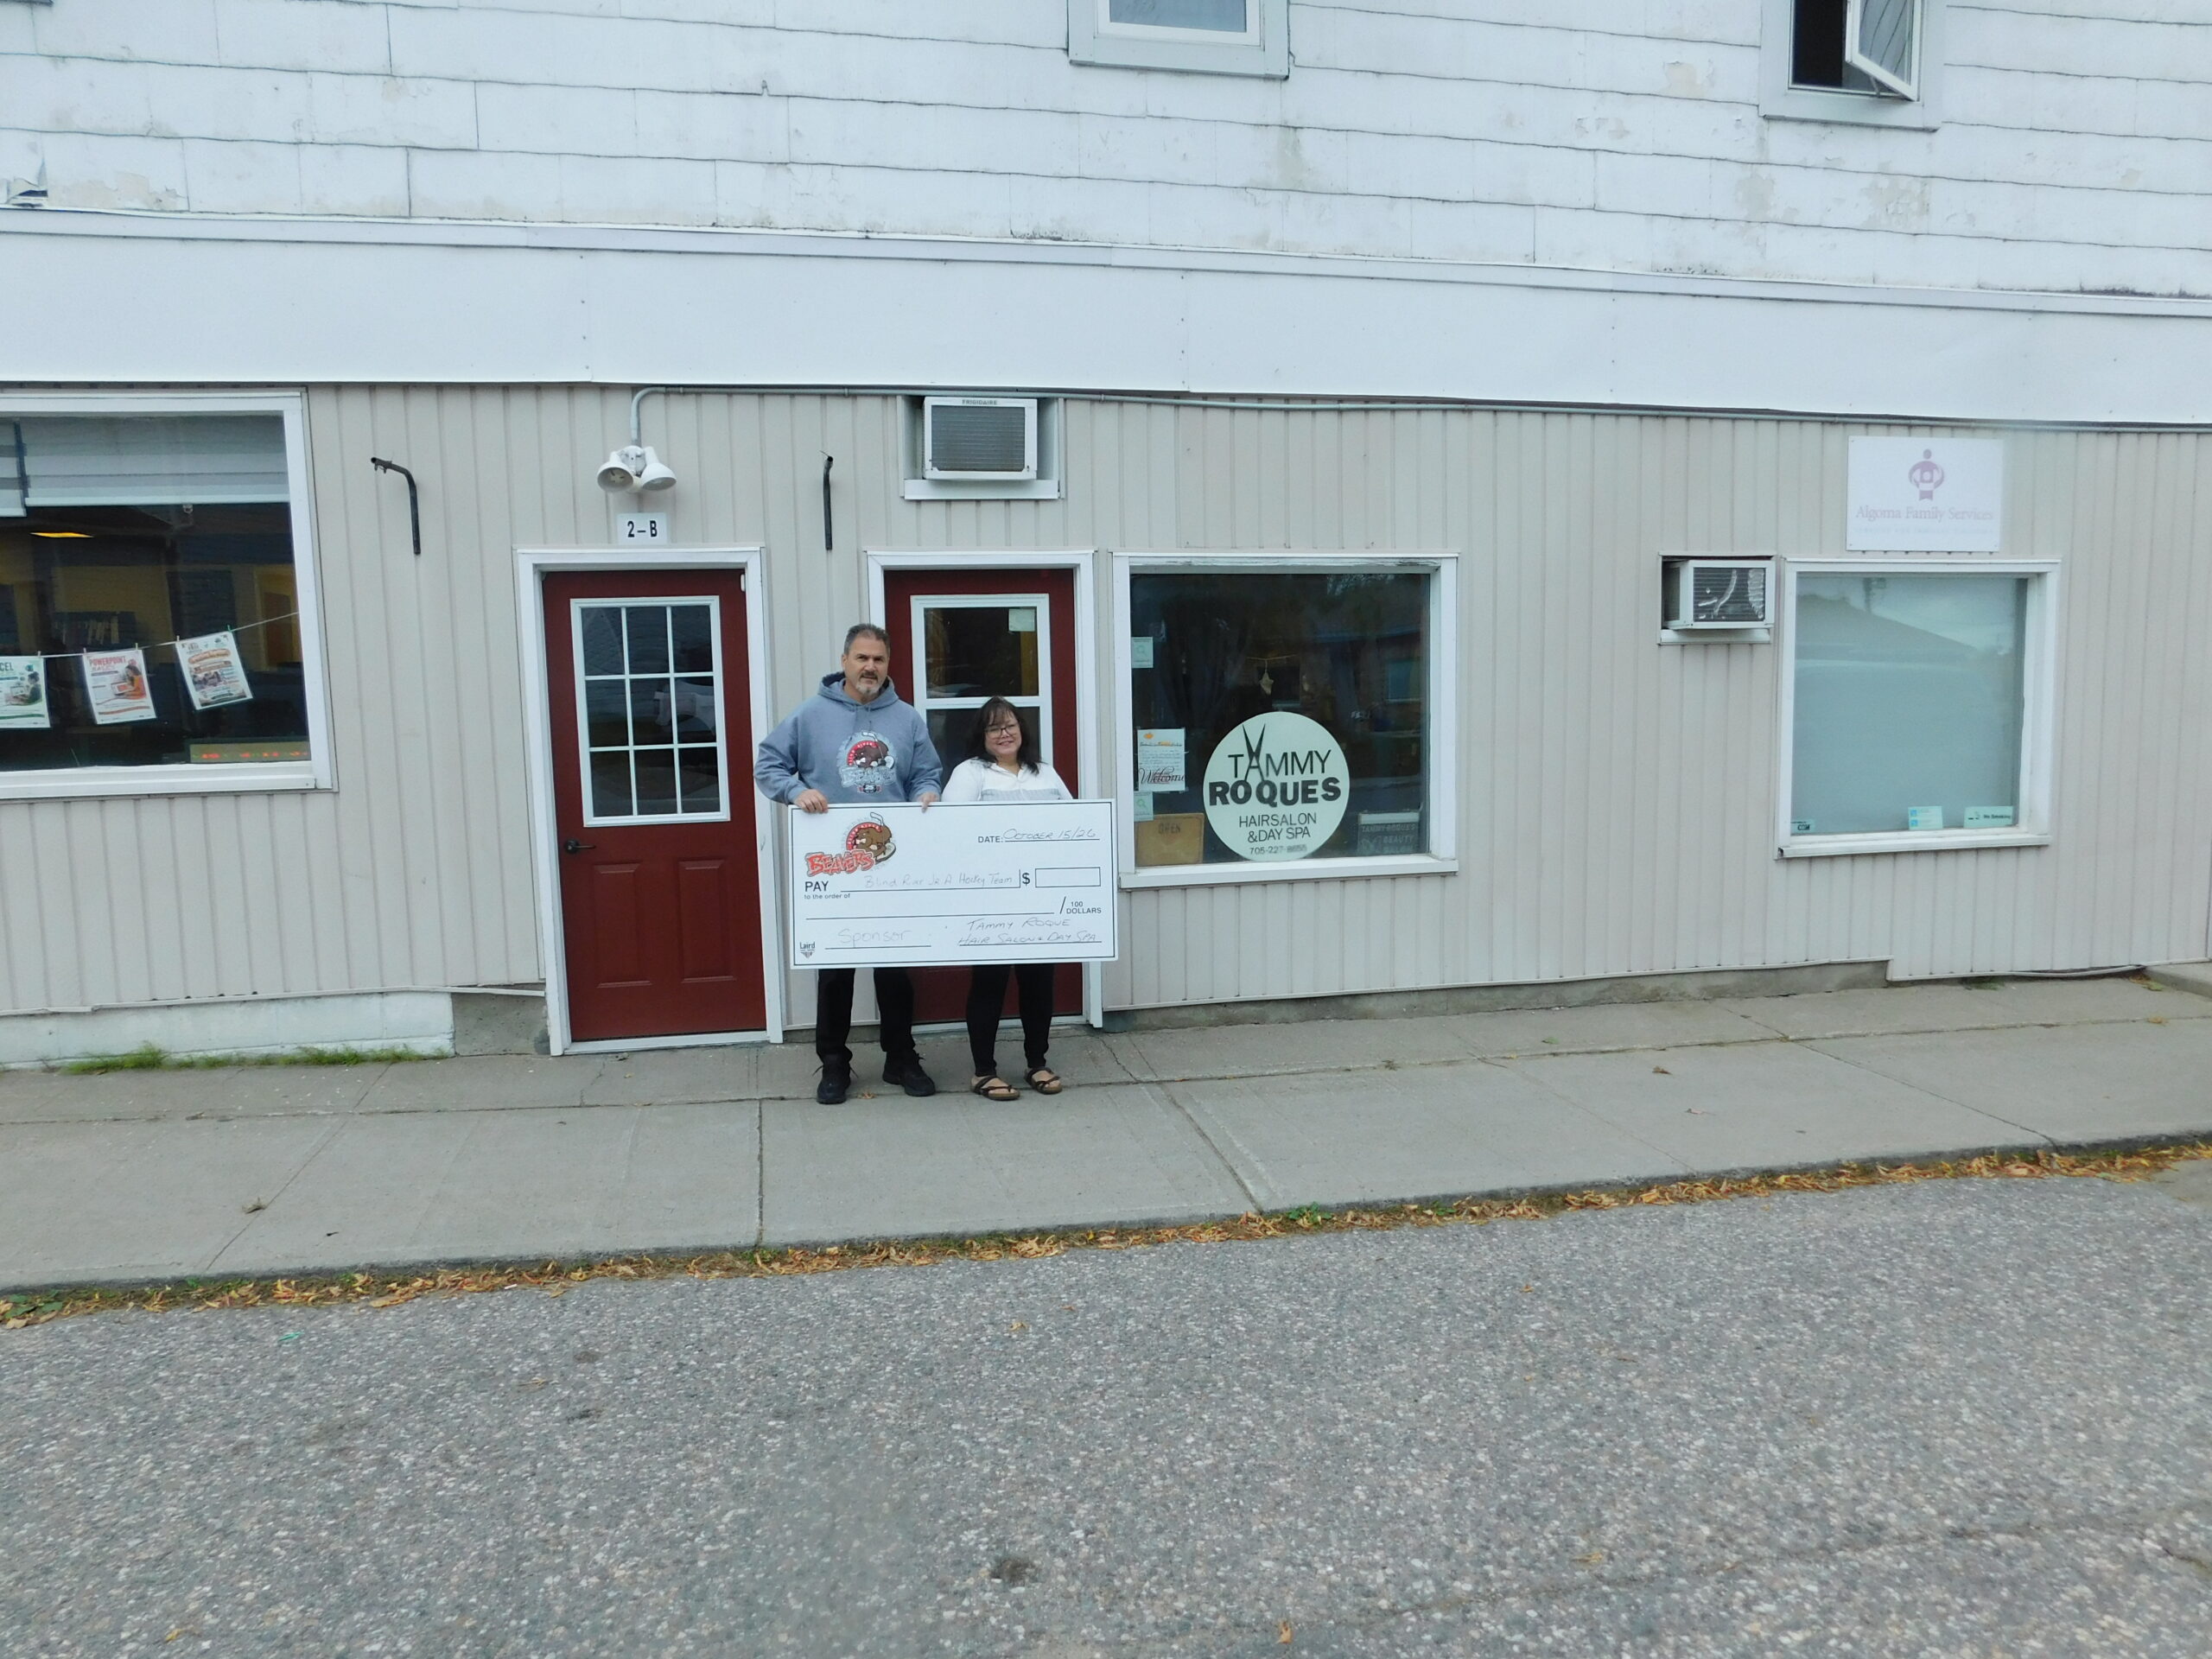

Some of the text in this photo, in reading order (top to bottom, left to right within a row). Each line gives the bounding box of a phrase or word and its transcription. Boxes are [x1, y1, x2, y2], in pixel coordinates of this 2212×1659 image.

[1856, 505, 1993, 523] Algoma Family Services
[627, 520, 658, 537] 2-B
[1228, 737, 1332, 781] TAMMY
[1209, 777, 1341, 807] ROQUES
[1239, 812, 1317, 828] HAIRSALON
[1248, 826, 1311, 843] &DAY SPA
[805, 849, 875, 877] BEAVERS
[804, 880, 829, 892] PAY
[799, 941, 816, 950] Laird
[837, 928, 913, 948] Sponsor
